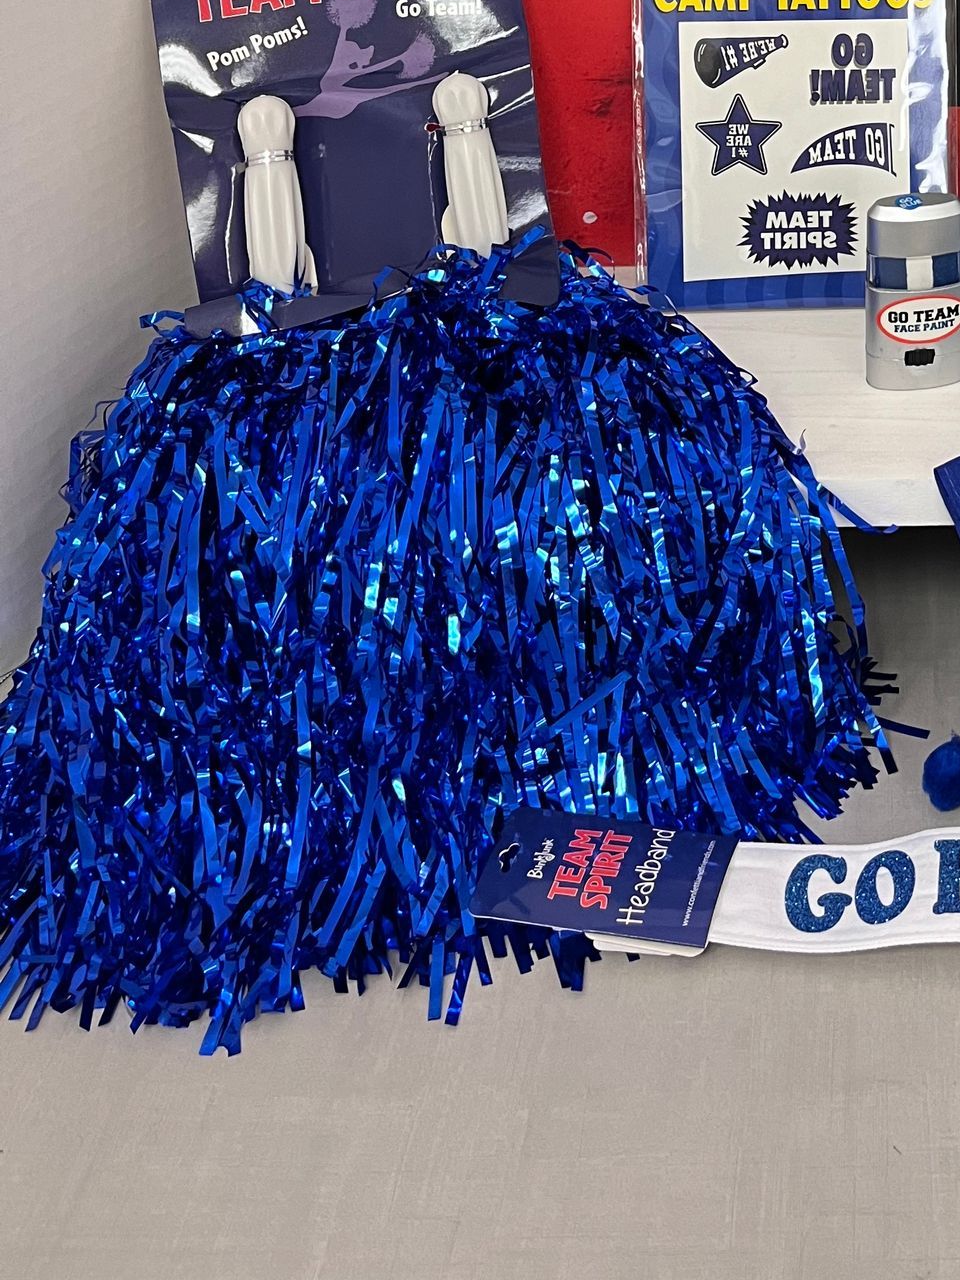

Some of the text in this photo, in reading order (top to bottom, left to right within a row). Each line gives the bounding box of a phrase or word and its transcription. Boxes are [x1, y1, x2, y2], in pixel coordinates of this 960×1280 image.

[206, 16, 309, 72] Pom Poms!
[888, 304, 960, 324] GO TEAM
[894, 319, 955, 333] FACE PAINT
[547, 828, 603, 900] TEAM
[579, 829, 634, 910] SPIRIT
[616, 828, 677, 925] Headband
[784, 849, 916, 934] GO
